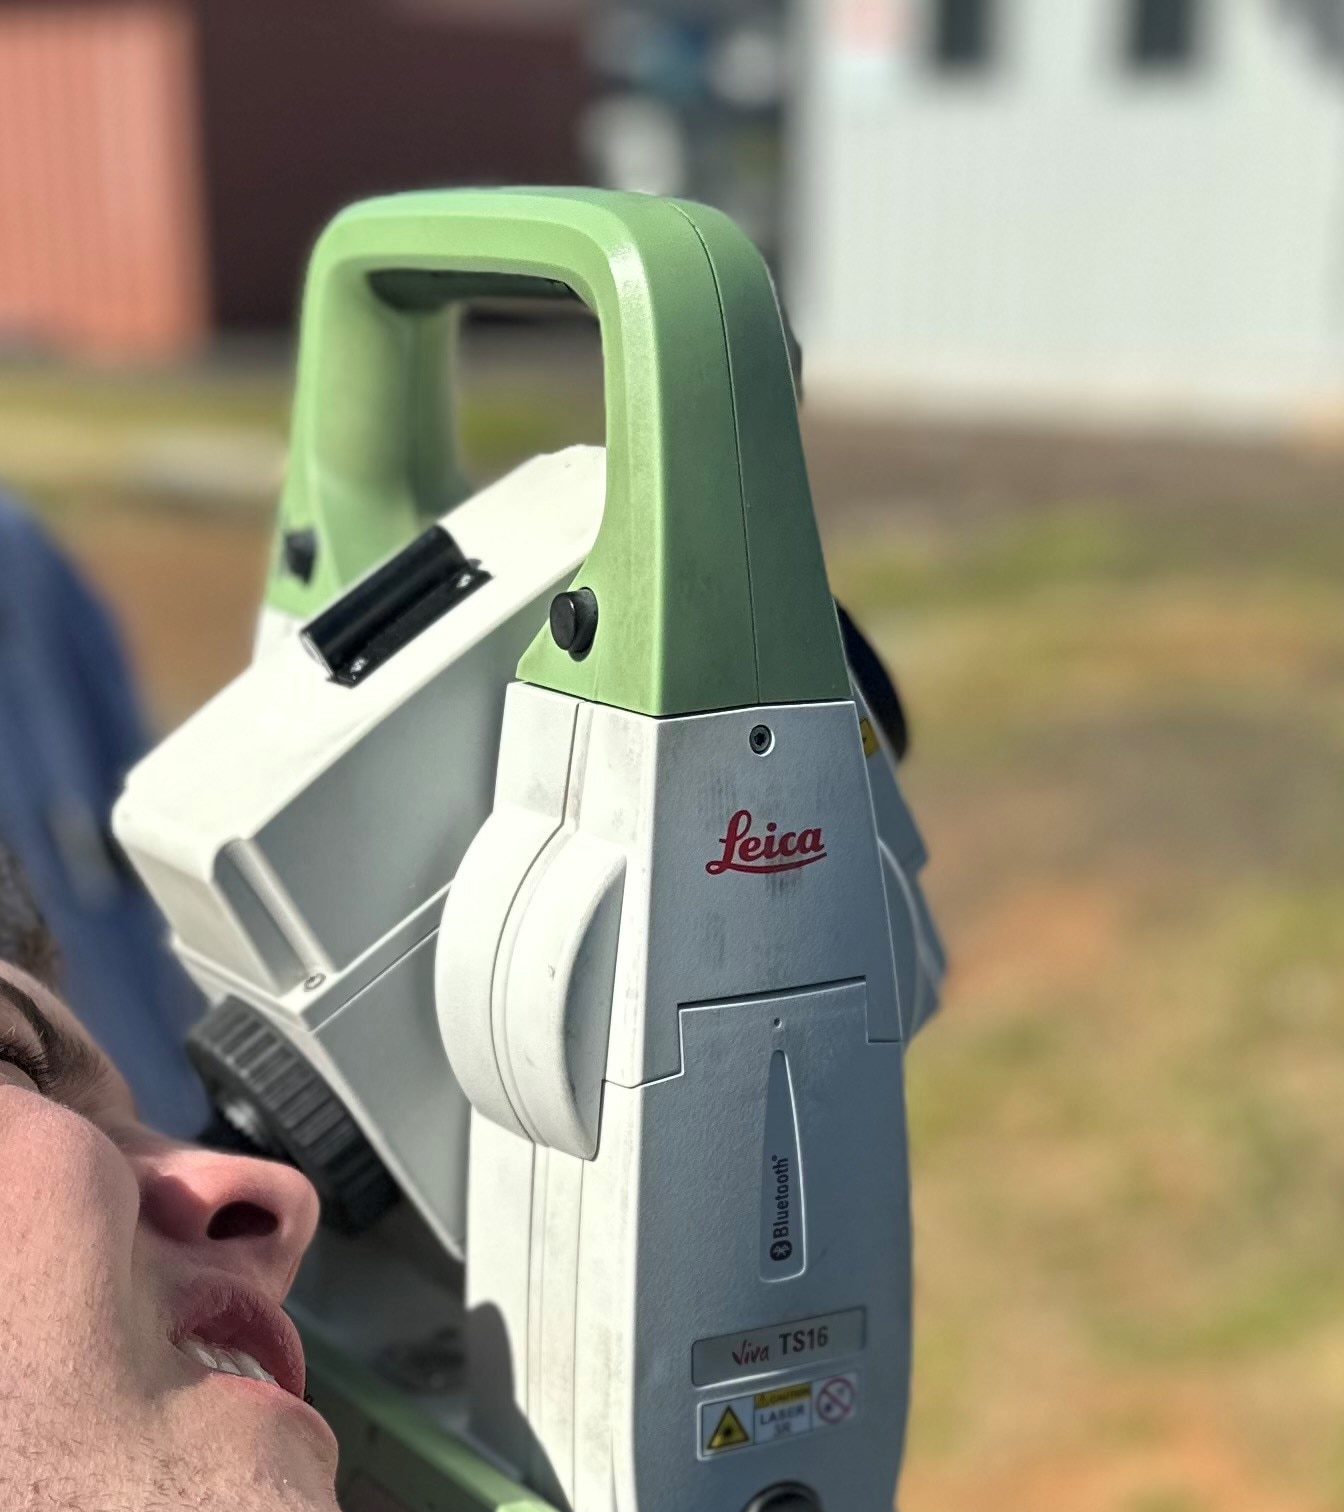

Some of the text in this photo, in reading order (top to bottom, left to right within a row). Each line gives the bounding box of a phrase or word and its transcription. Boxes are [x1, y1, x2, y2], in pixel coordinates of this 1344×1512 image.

[706, 809, 827, 875] Leica
[732, 1326, 829, 1366] Viva TS16
[760, 1404, 805, 1426] LASER
